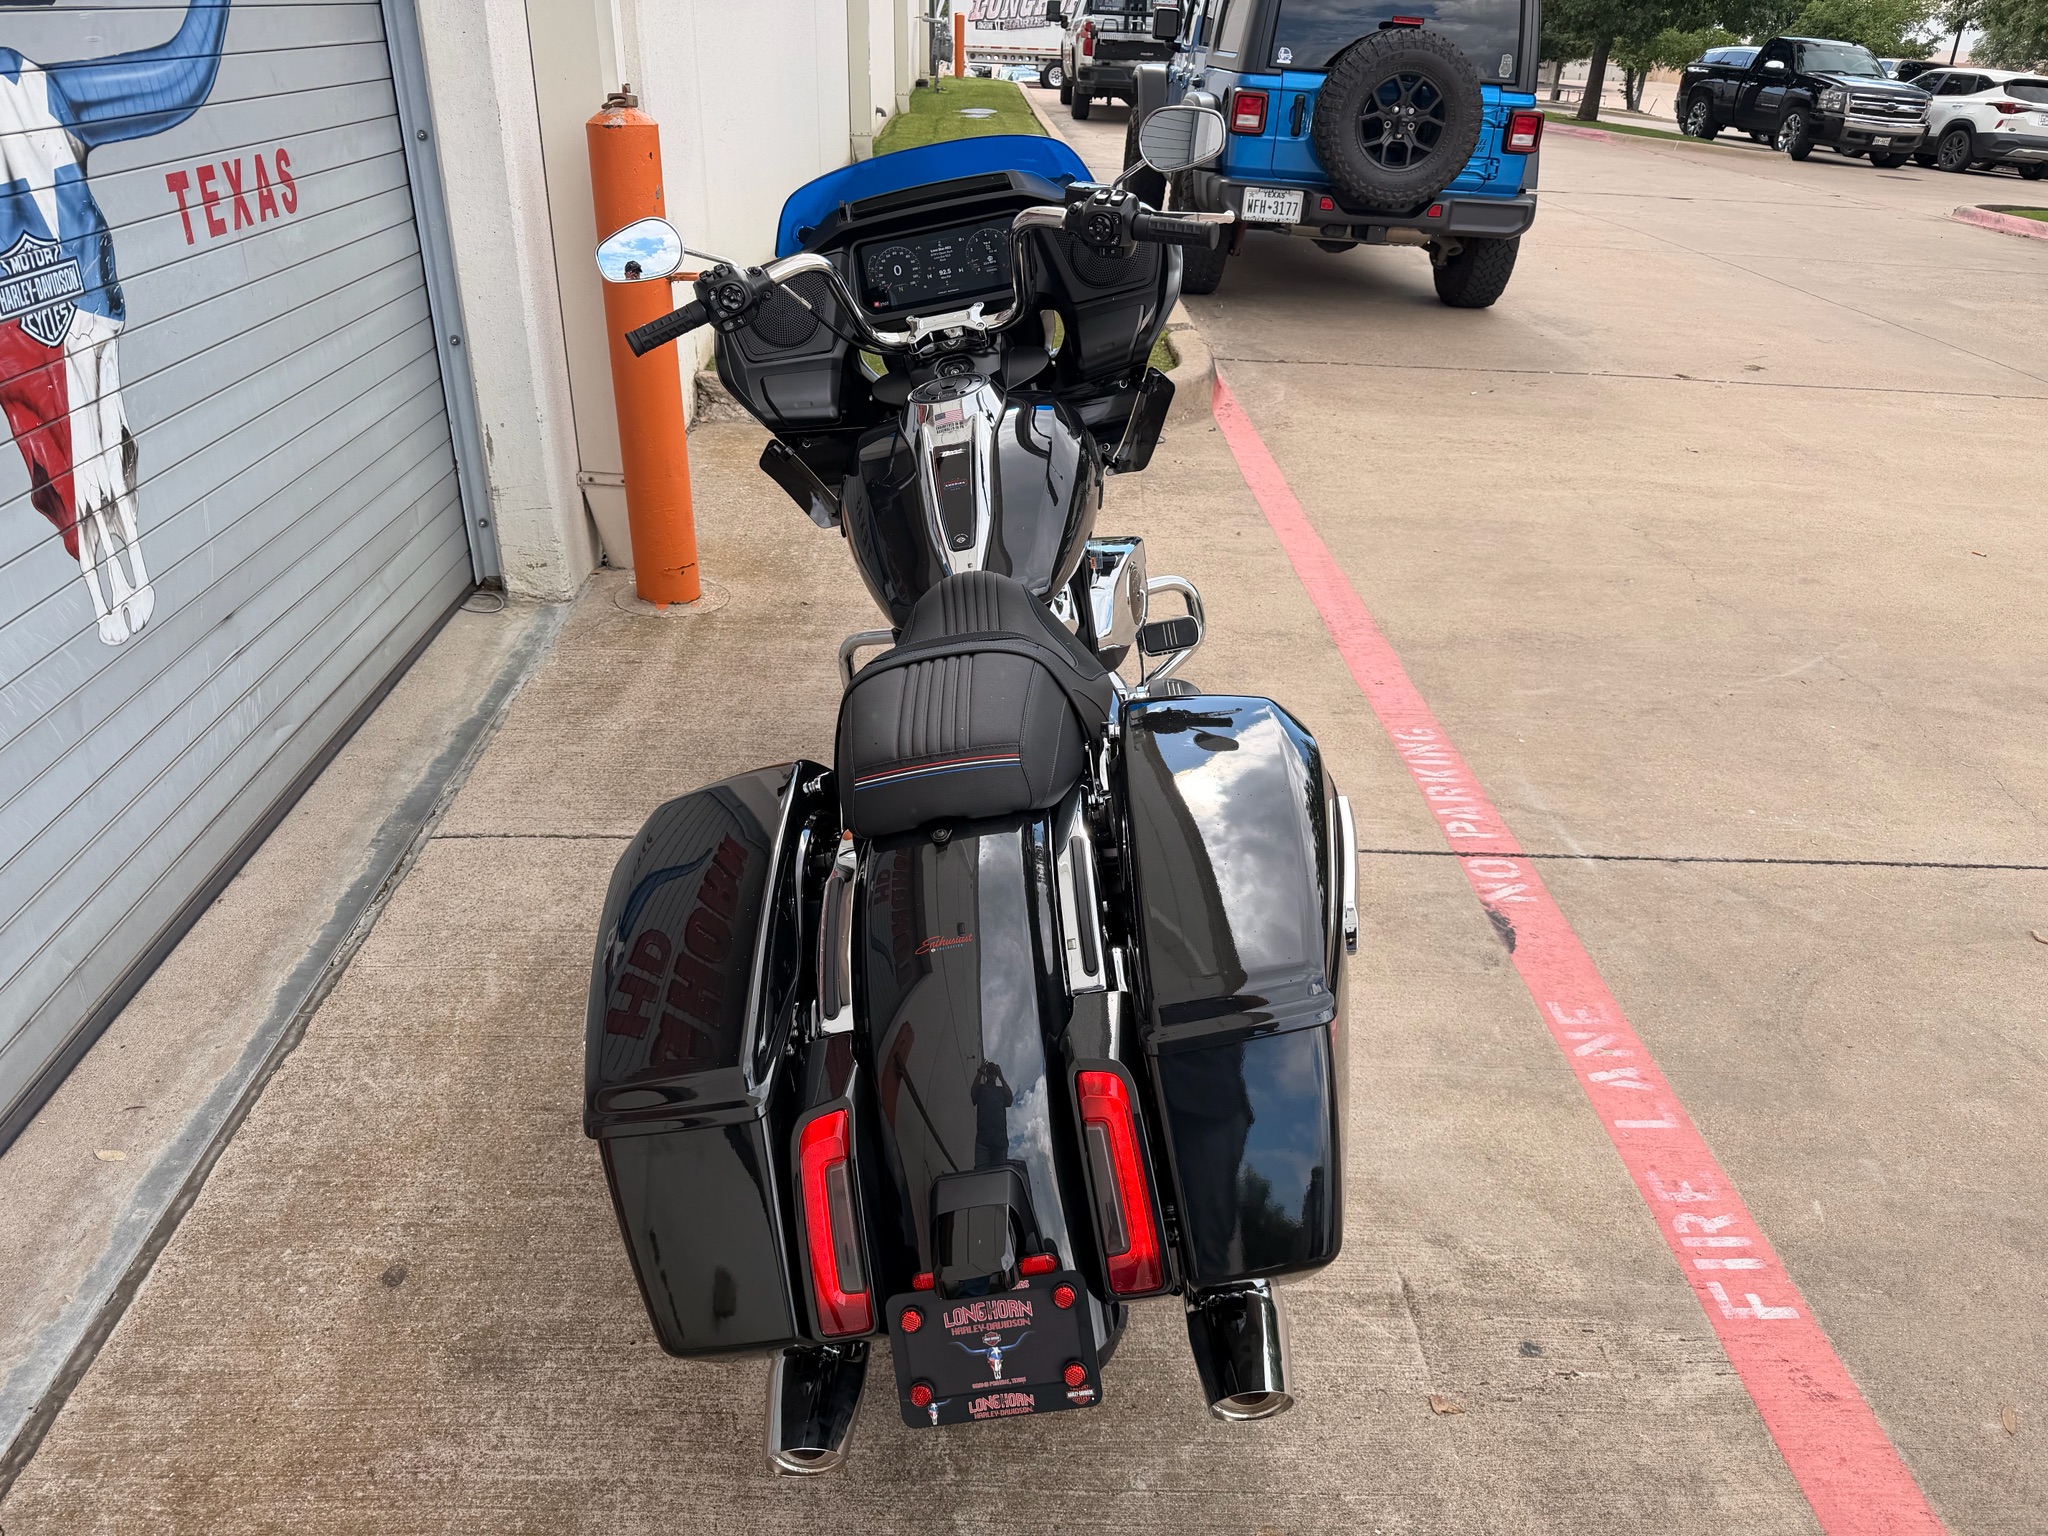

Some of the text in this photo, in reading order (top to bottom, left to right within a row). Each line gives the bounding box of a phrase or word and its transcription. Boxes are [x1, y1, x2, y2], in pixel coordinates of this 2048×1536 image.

[165, 147, 299, 246] TEXAS
[9, 248, 59, 276] MOTOR
[893, 265, 902, 276] 0
[0, 265, 80, 314] HARLEY-DAVIDSON
[26, 302, 68, 341] CYCLES
[915, 933, 973, 954] Enthusiast
[1392, 725, 1801, 1321] FIRE LANE NO PARKING
[943, 1299, 1034, 1329] LONGHORN
[951, 1317, 1032, 1336] HARLEY-DAVIDSON
[968, 1392, 1035, 1414] LONGHORN
[973, 1406, 1034, 1419] HARLEY-DAVIDSON
